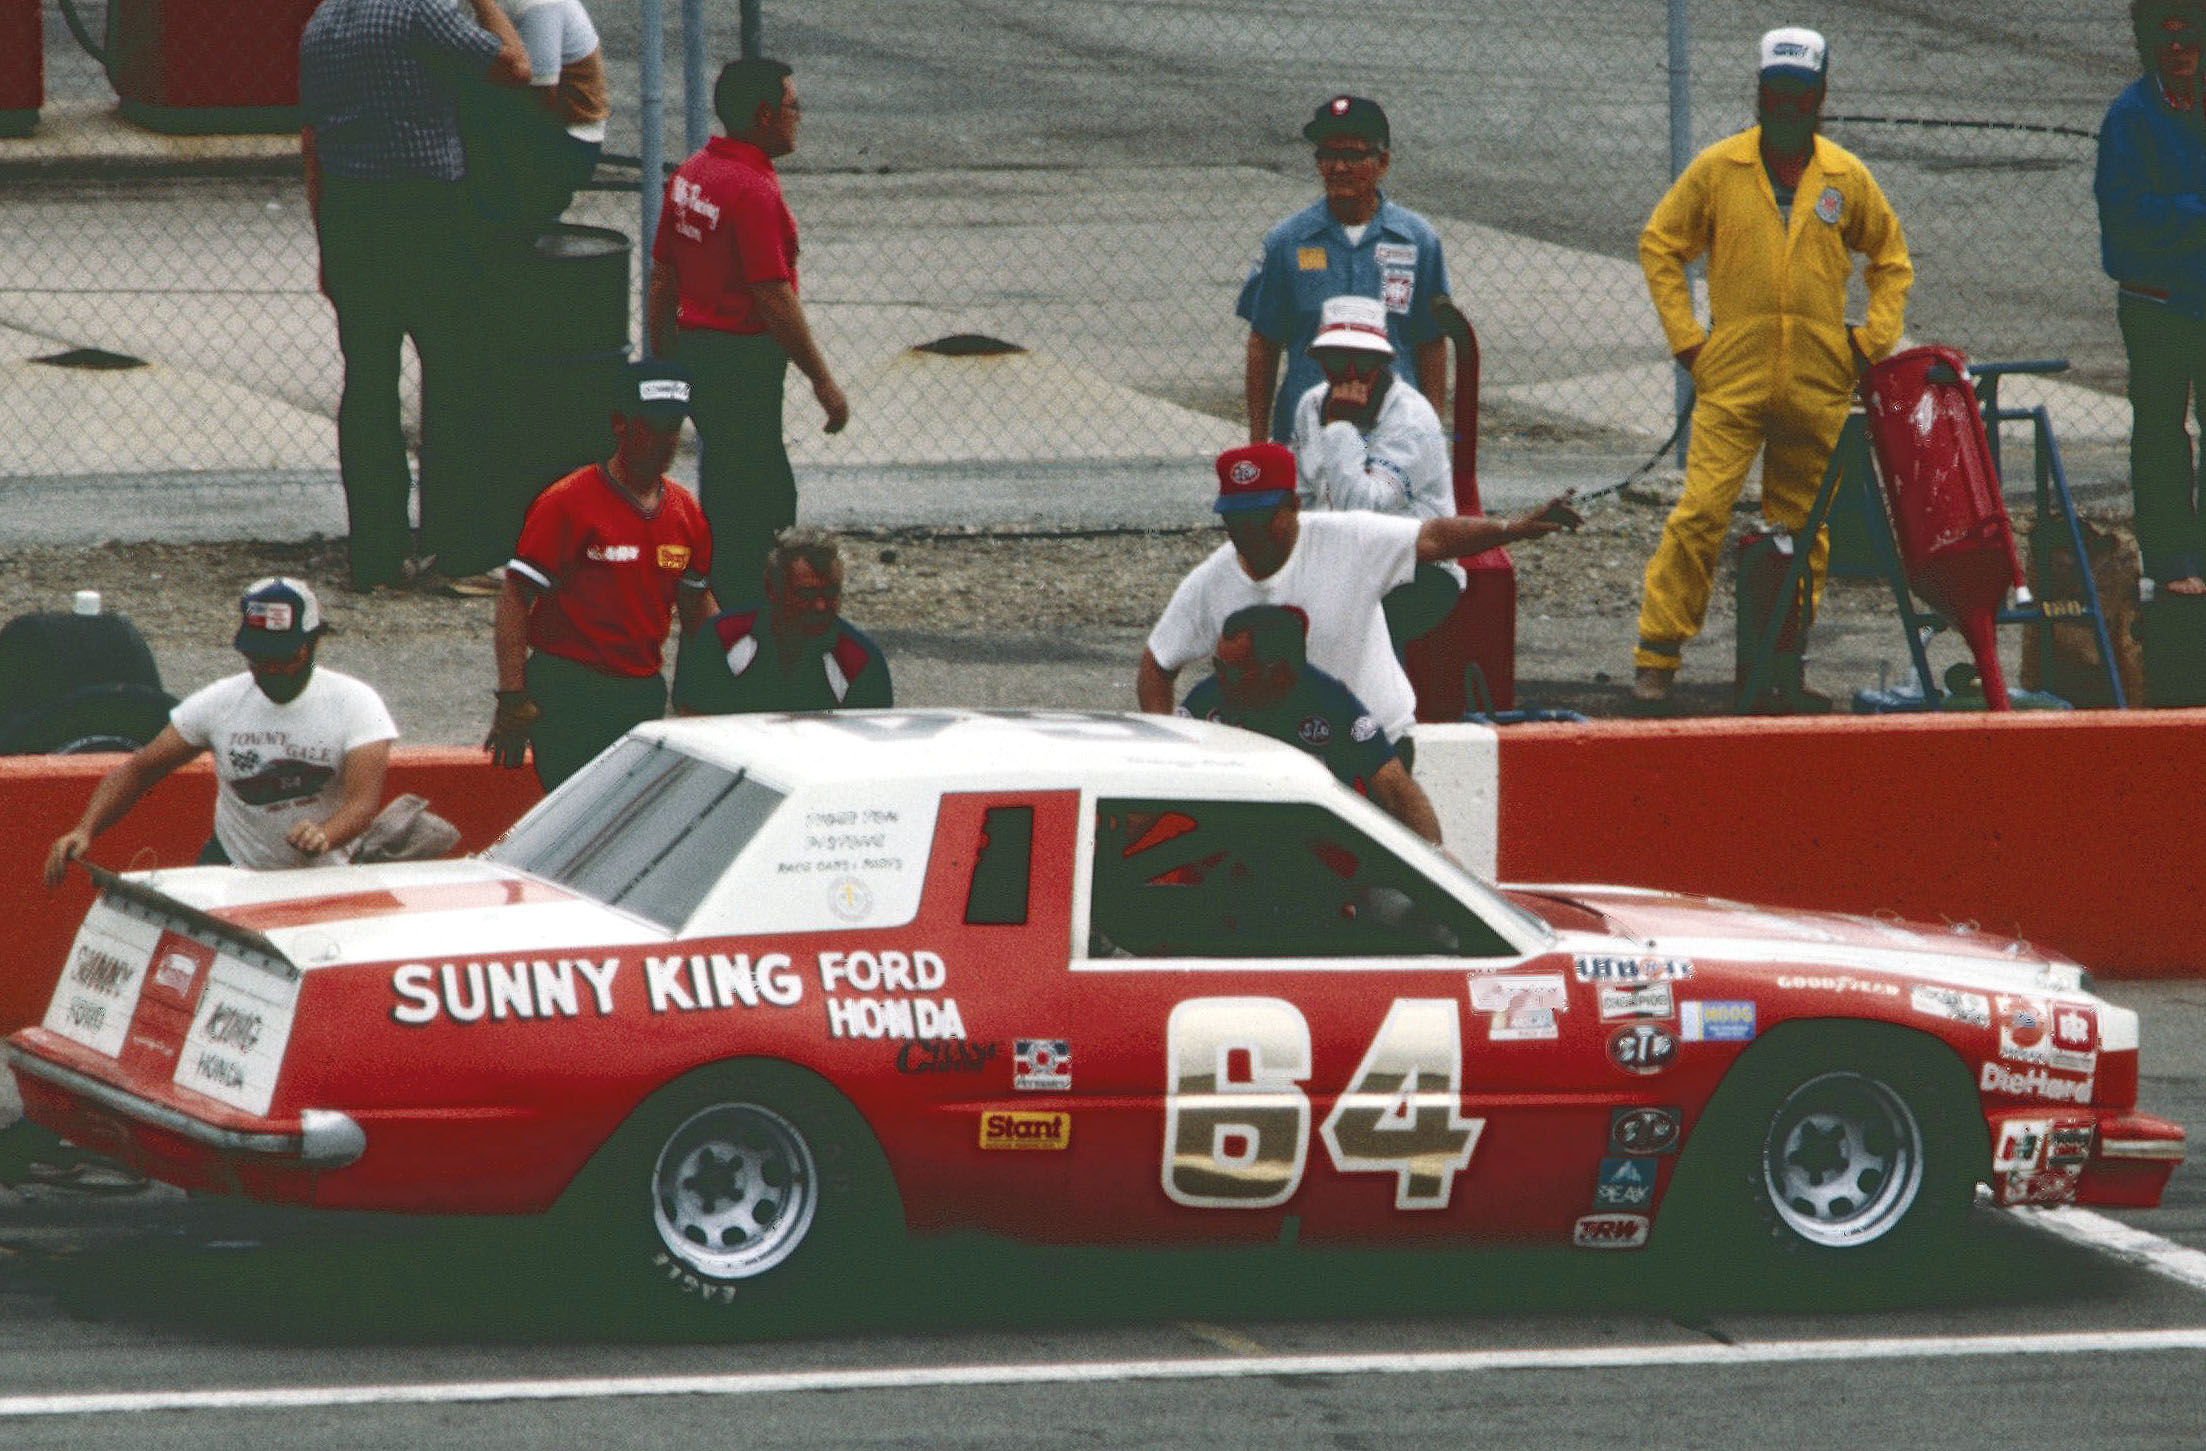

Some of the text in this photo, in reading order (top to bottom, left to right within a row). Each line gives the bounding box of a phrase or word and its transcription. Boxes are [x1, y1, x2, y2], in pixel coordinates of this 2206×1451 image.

[391, 953, 803, 1024] SUNNY KING
[818, 950, 947, 993] FORD
[826, 998, 966, 1039] HONDA
[1161, 996, 1486, 1210] 64
[1981, 1061, 2094, 1104] DieHard
[986, 1114, 1063, 1139] Stant
[1579, 1219, 1640, 1241] TRW
